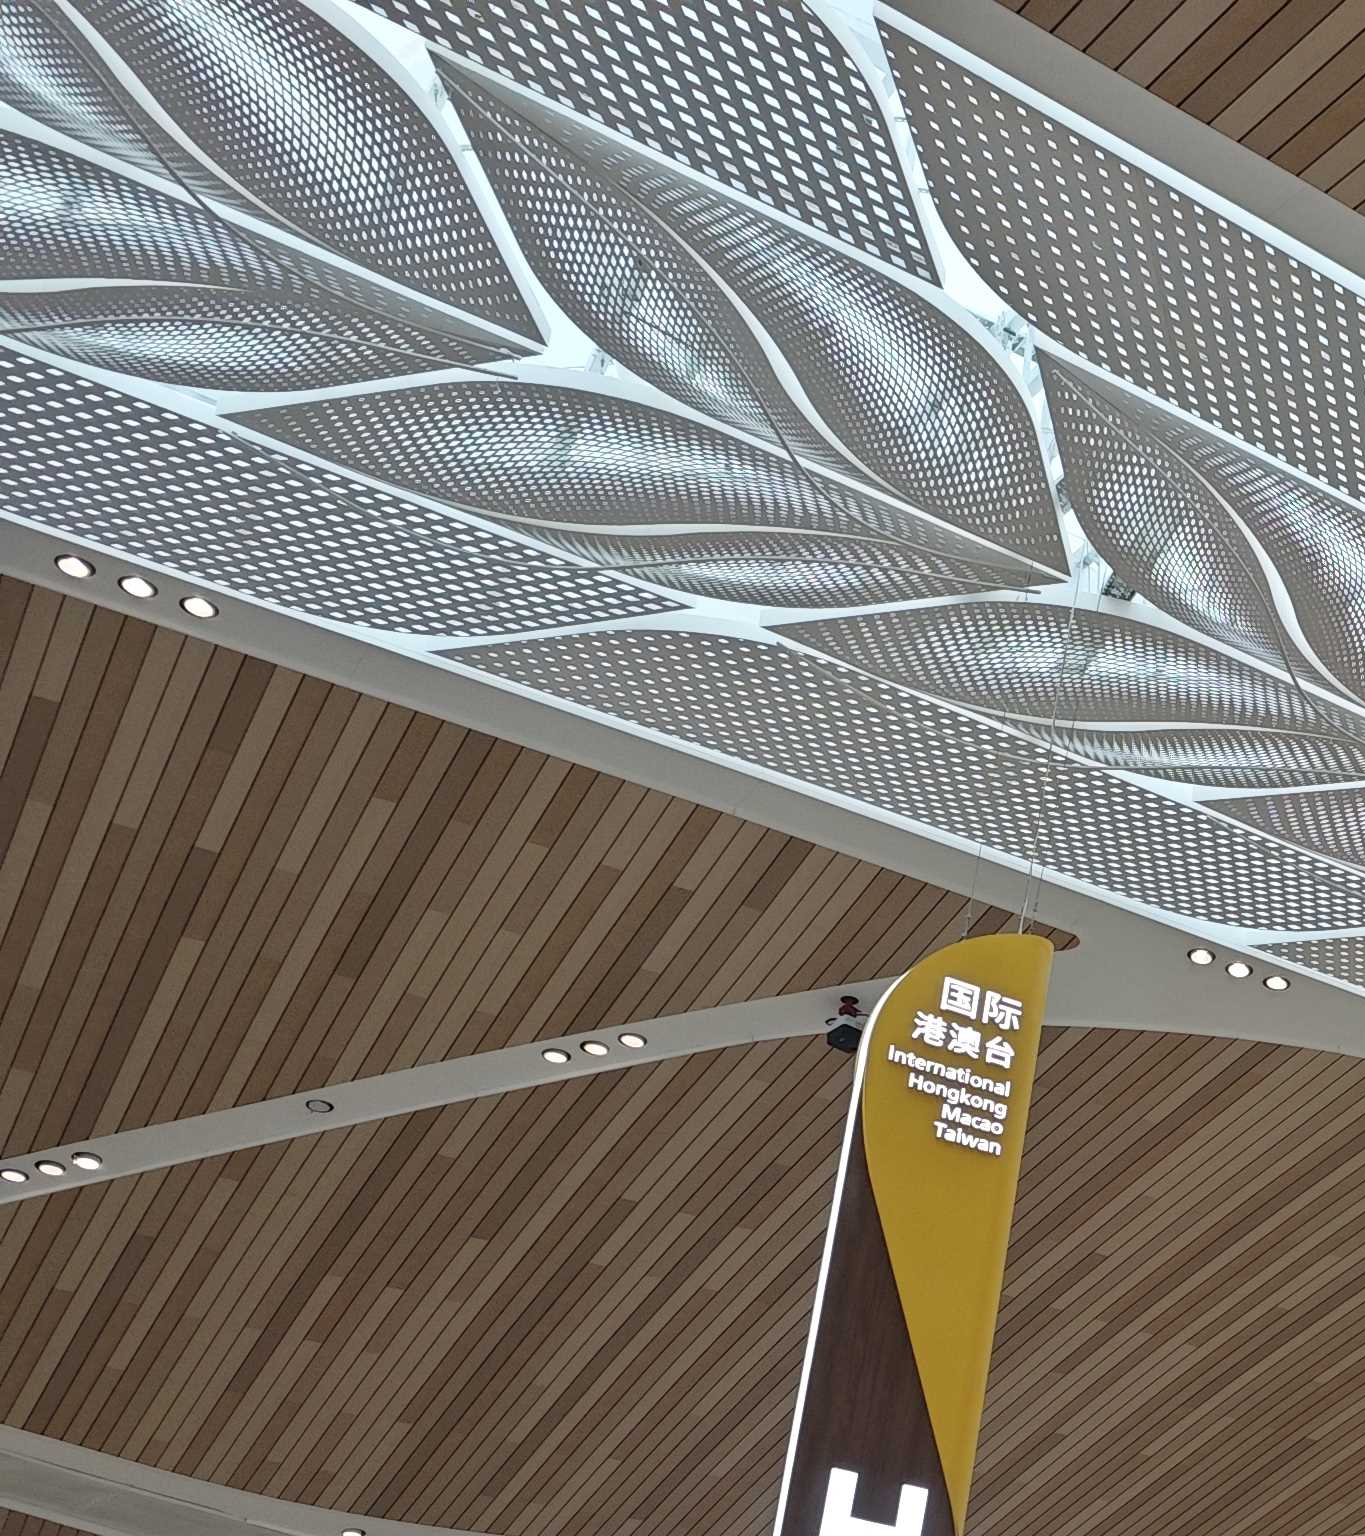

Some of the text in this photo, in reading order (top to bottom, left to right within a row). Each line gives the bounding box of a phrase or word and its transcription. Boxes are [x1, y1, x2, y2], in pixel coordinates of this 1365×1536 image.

[940, 976, 1023, 1030] 国际
[911, 1011, 1015, 1069] 港澳台
[888, 1044, 1012, 1098] International
[908, 1072, 1008, 1120] Hongkong
[933, 1120, 1002, 1156] Taiwan
[941, 1103, 1004, 1136] Macao
